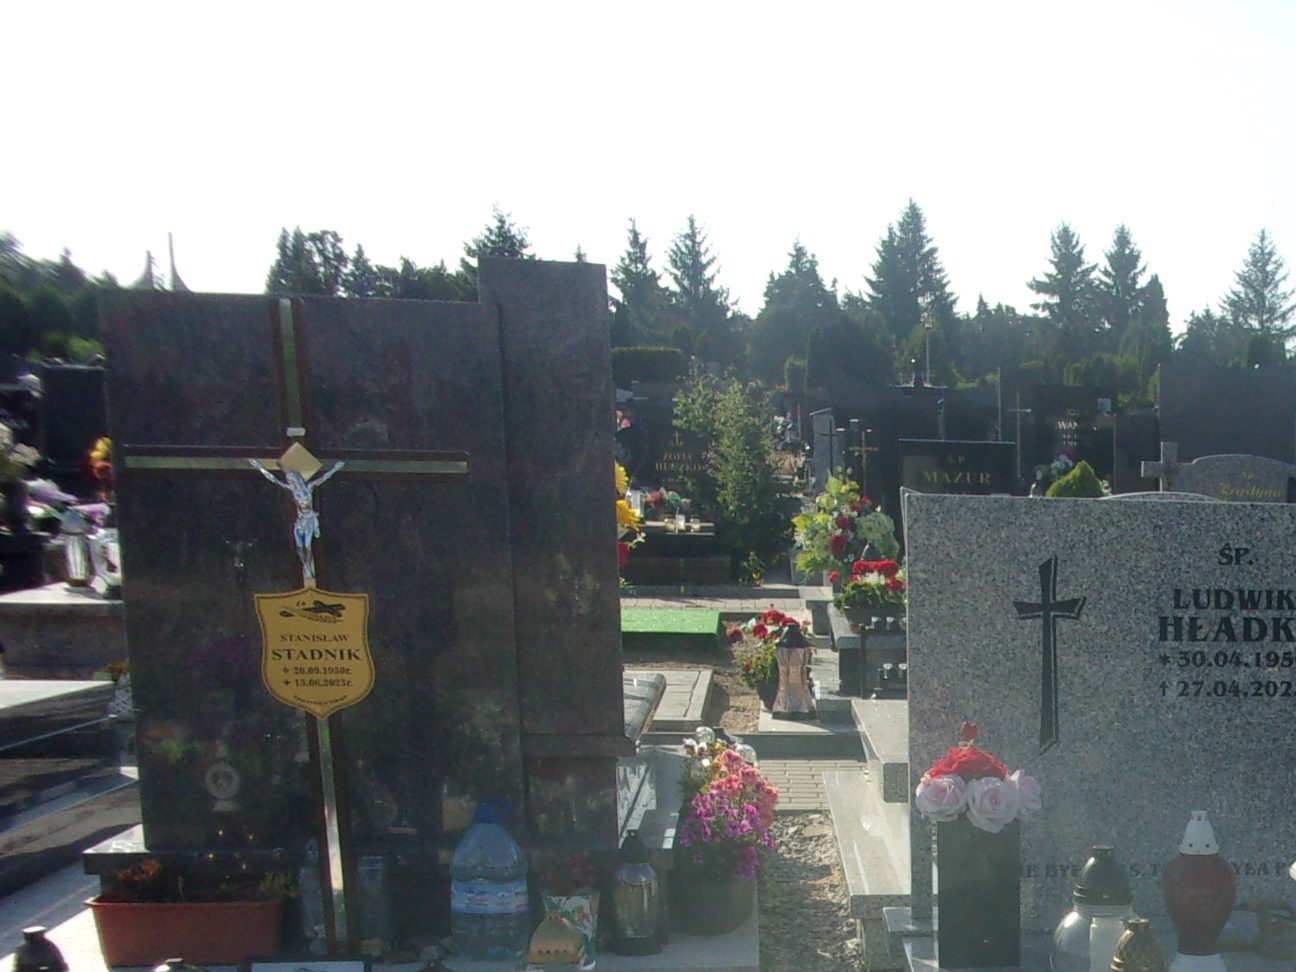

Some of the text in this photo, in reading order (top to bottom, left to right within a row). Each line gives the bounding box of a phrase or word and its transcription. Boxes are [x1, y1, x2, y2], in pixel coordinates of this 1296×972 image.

[921, 471, 991, 484] MAZUR
[1173, 588, 1296, 611] LUDWIK
[271, 648, 361, 661] STADNIK
